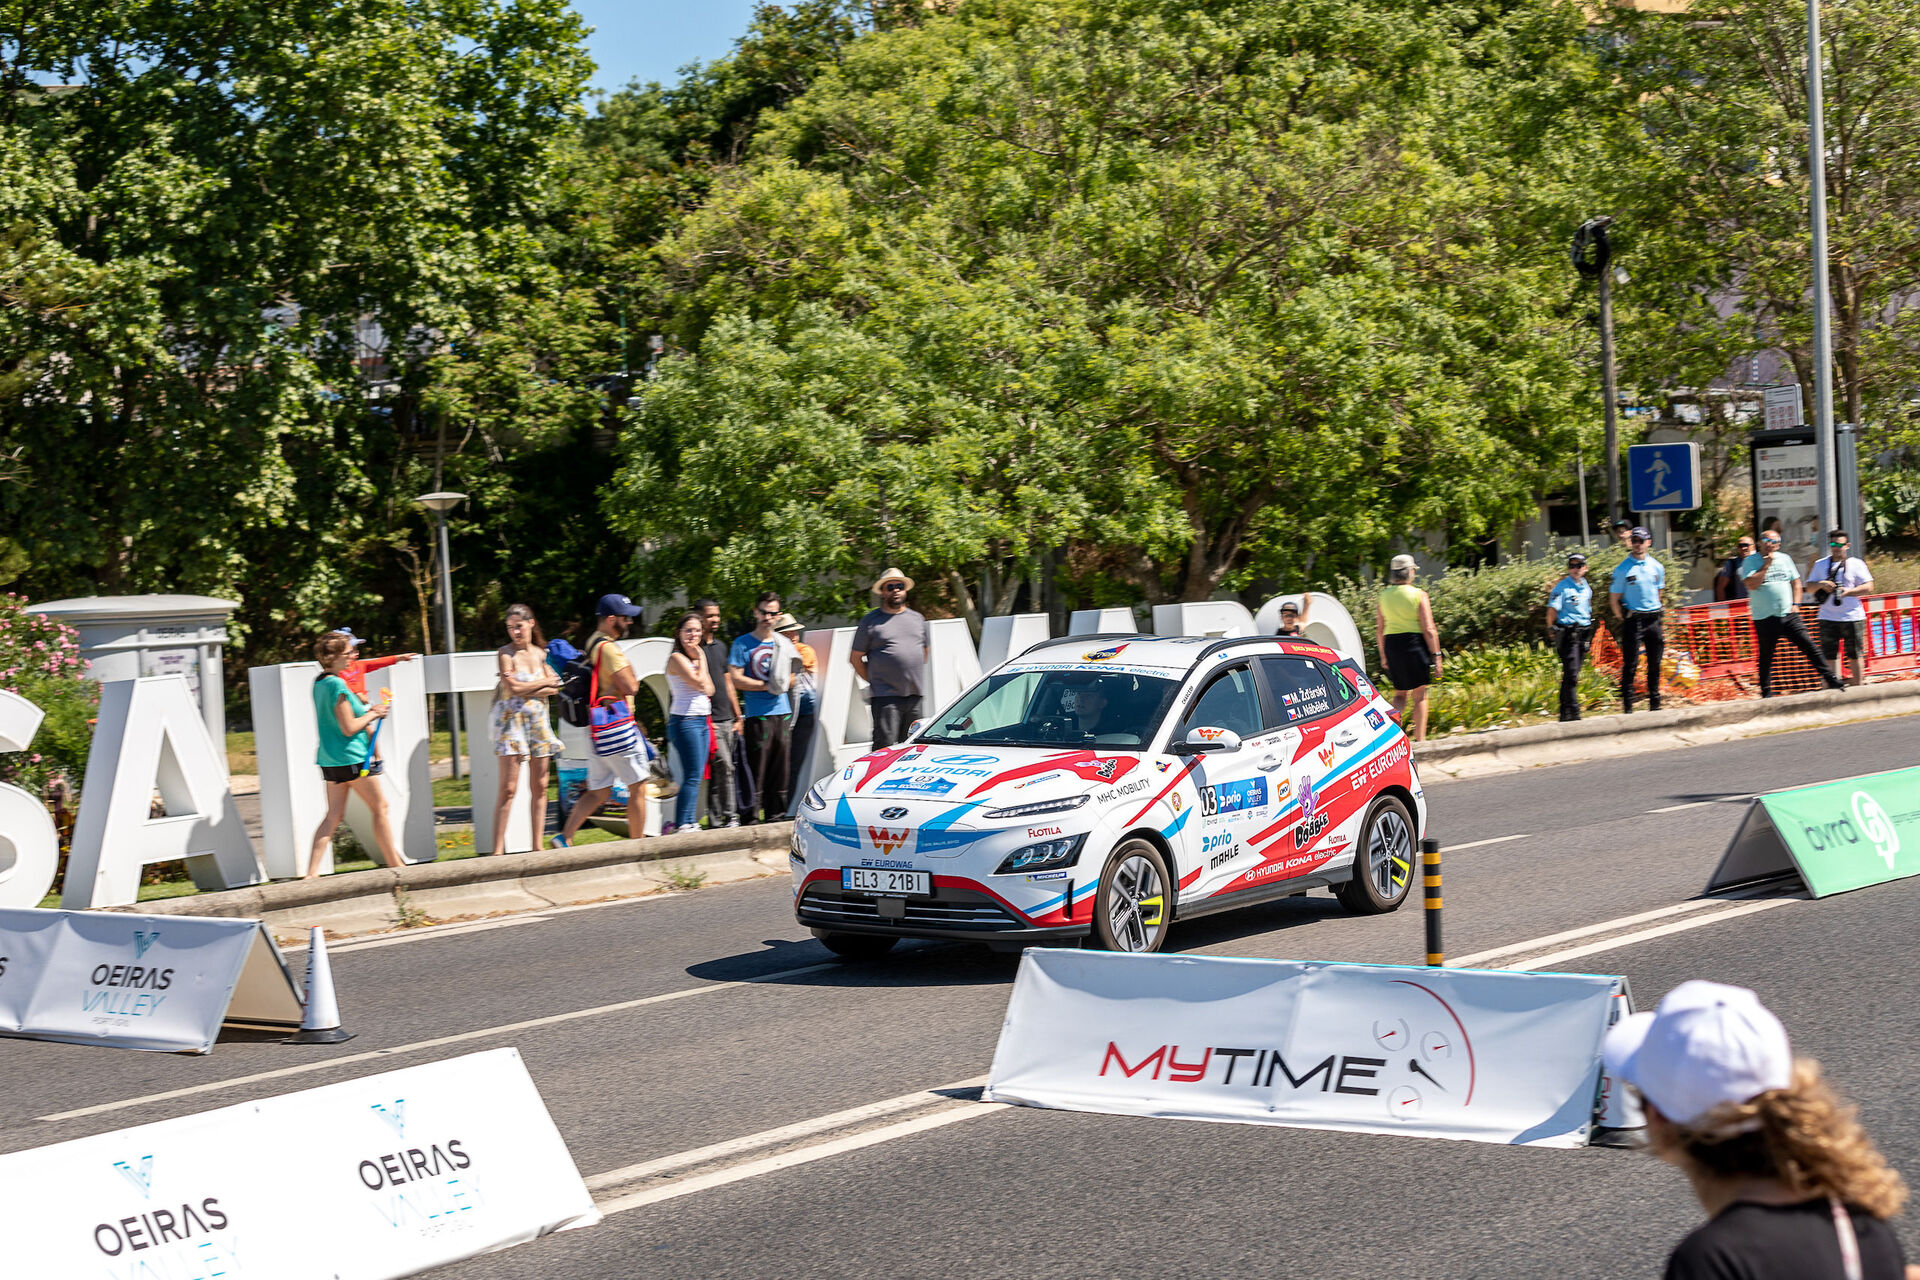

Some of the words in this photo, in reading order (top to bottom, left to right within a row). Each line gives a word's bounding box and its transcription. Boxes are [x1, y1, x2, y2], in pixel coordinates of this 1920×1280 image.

[1129, 667, 1170, 677] electric
[1331, 664, 1349, 700] 3
[1290, 692, 1300, 704] M.
[1299, 684, 1327, 702] Žďárský
[1302, 700, 1330, 717] Nábělek
[892, 767, 992, 777] HYUNDAI
[1369, 741, 1408, 779] EUROWAG
[915, 775, 934, 783] 03
[1097, 790, 1117, 804] MHC
[1117, 778, 1151, 800] MOBILITY
[1200, 786, 1217, 816] 03
[1226, 790, 1241, 806] prio
[1210, 829, 1232, 851] prio
[875, 859, 913, 868] EUROWAG
[1210, 844, 1239, 870] MAHLE
[1256, 862, 1284, 878] HYUNDAI
[1286, 854, 1312, 869] KONA
[1314, 848, 1337, 861] electric
[853, 871, 878, 889] EL3
[889, 873, 921, 891] 21BI
[91, 963, 175, 990] OEIRAS
[82, 990, 167, 1017] VALLEY
[1099, 1041, 1387, 1097] MYTIME
[358, 1139, 471, 1191] OEIRAS
[94, 1197, 228, 1257] OEIRAS
